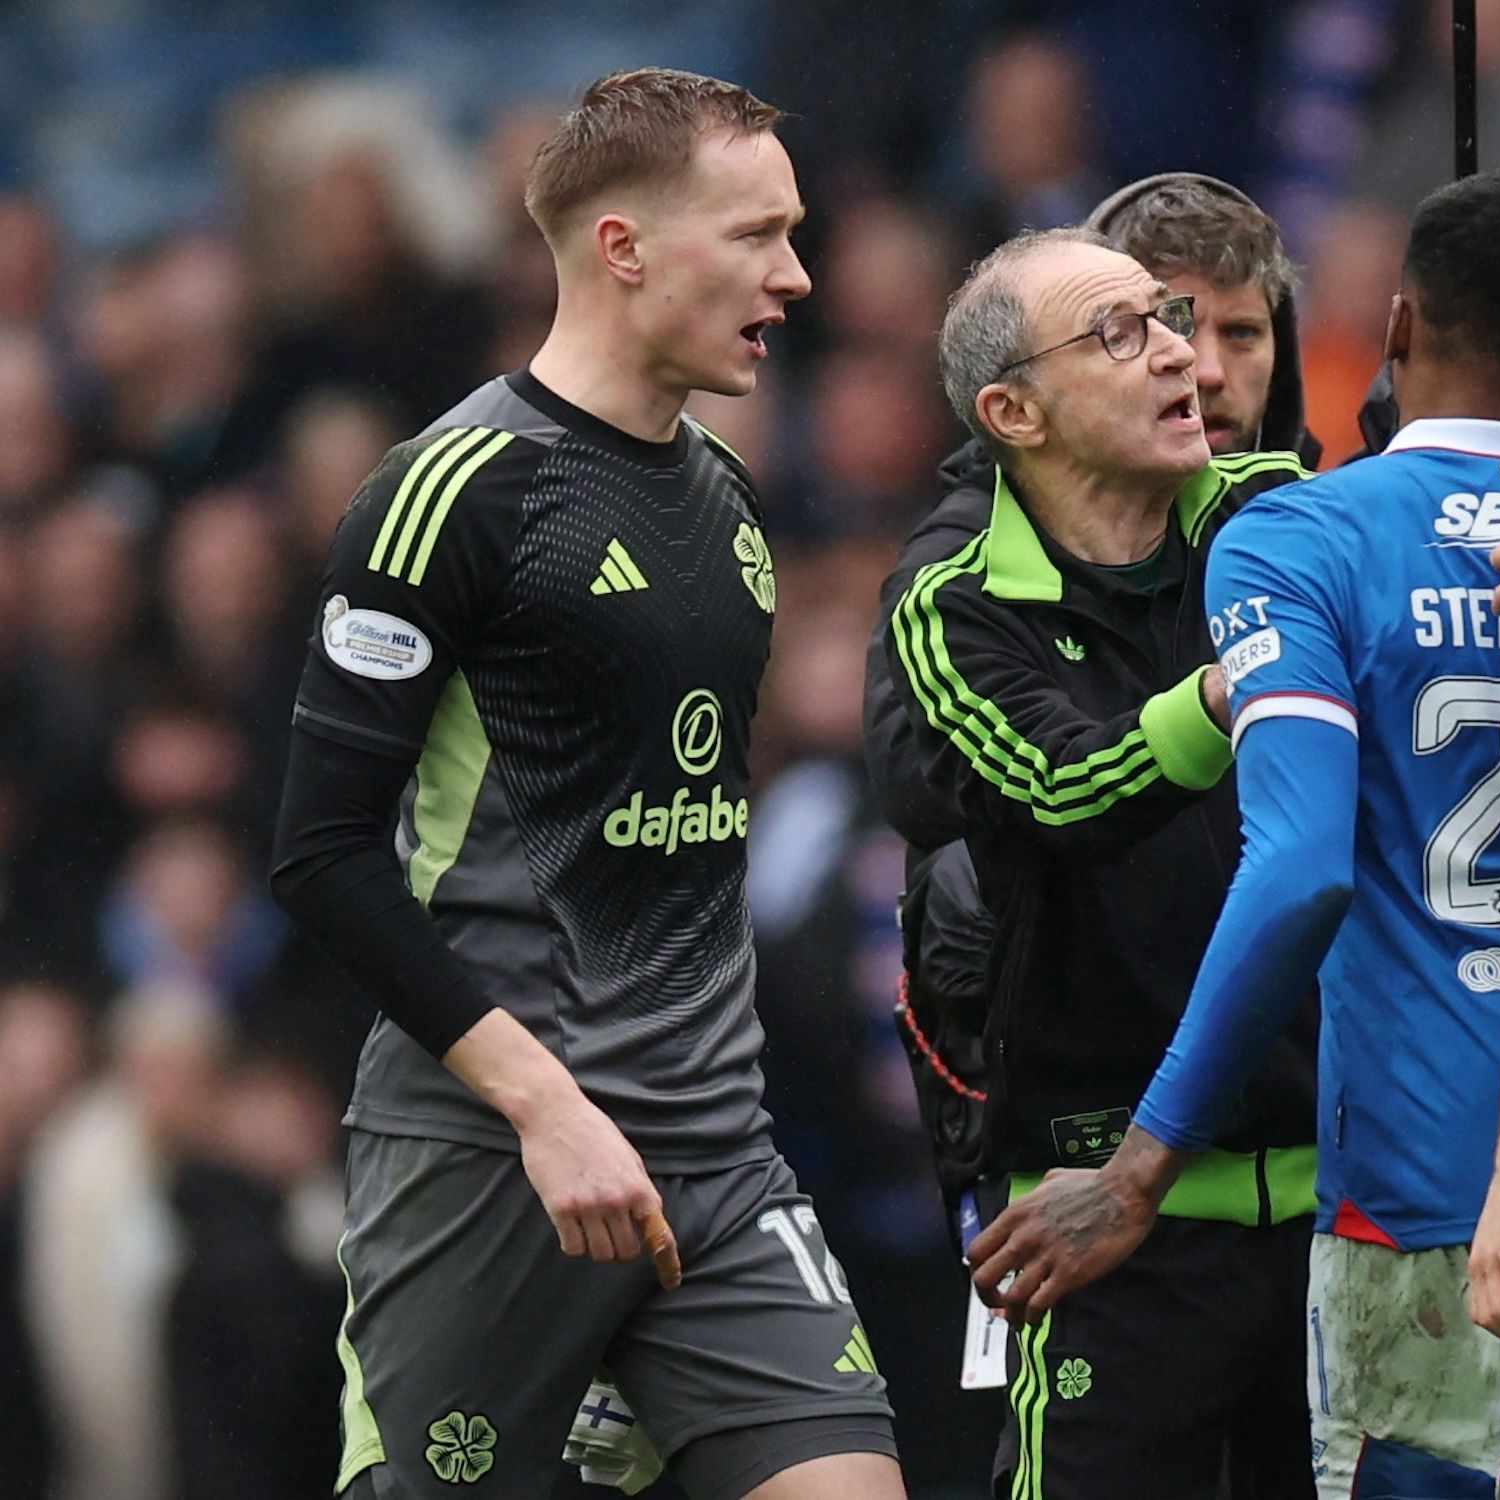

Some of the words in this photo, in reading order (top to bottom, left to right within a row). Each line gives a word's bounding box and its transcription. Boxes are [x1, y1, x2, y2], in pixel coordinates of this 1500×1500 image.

[391, 632, 417, 649] HILL
[1210, 596, 1270, 647] OXT
[350, 651, 403, 671] CHAMPIONS
[1224, 638, 1272, 676] ILERS
[603, 784, 748, 857] dafabe
